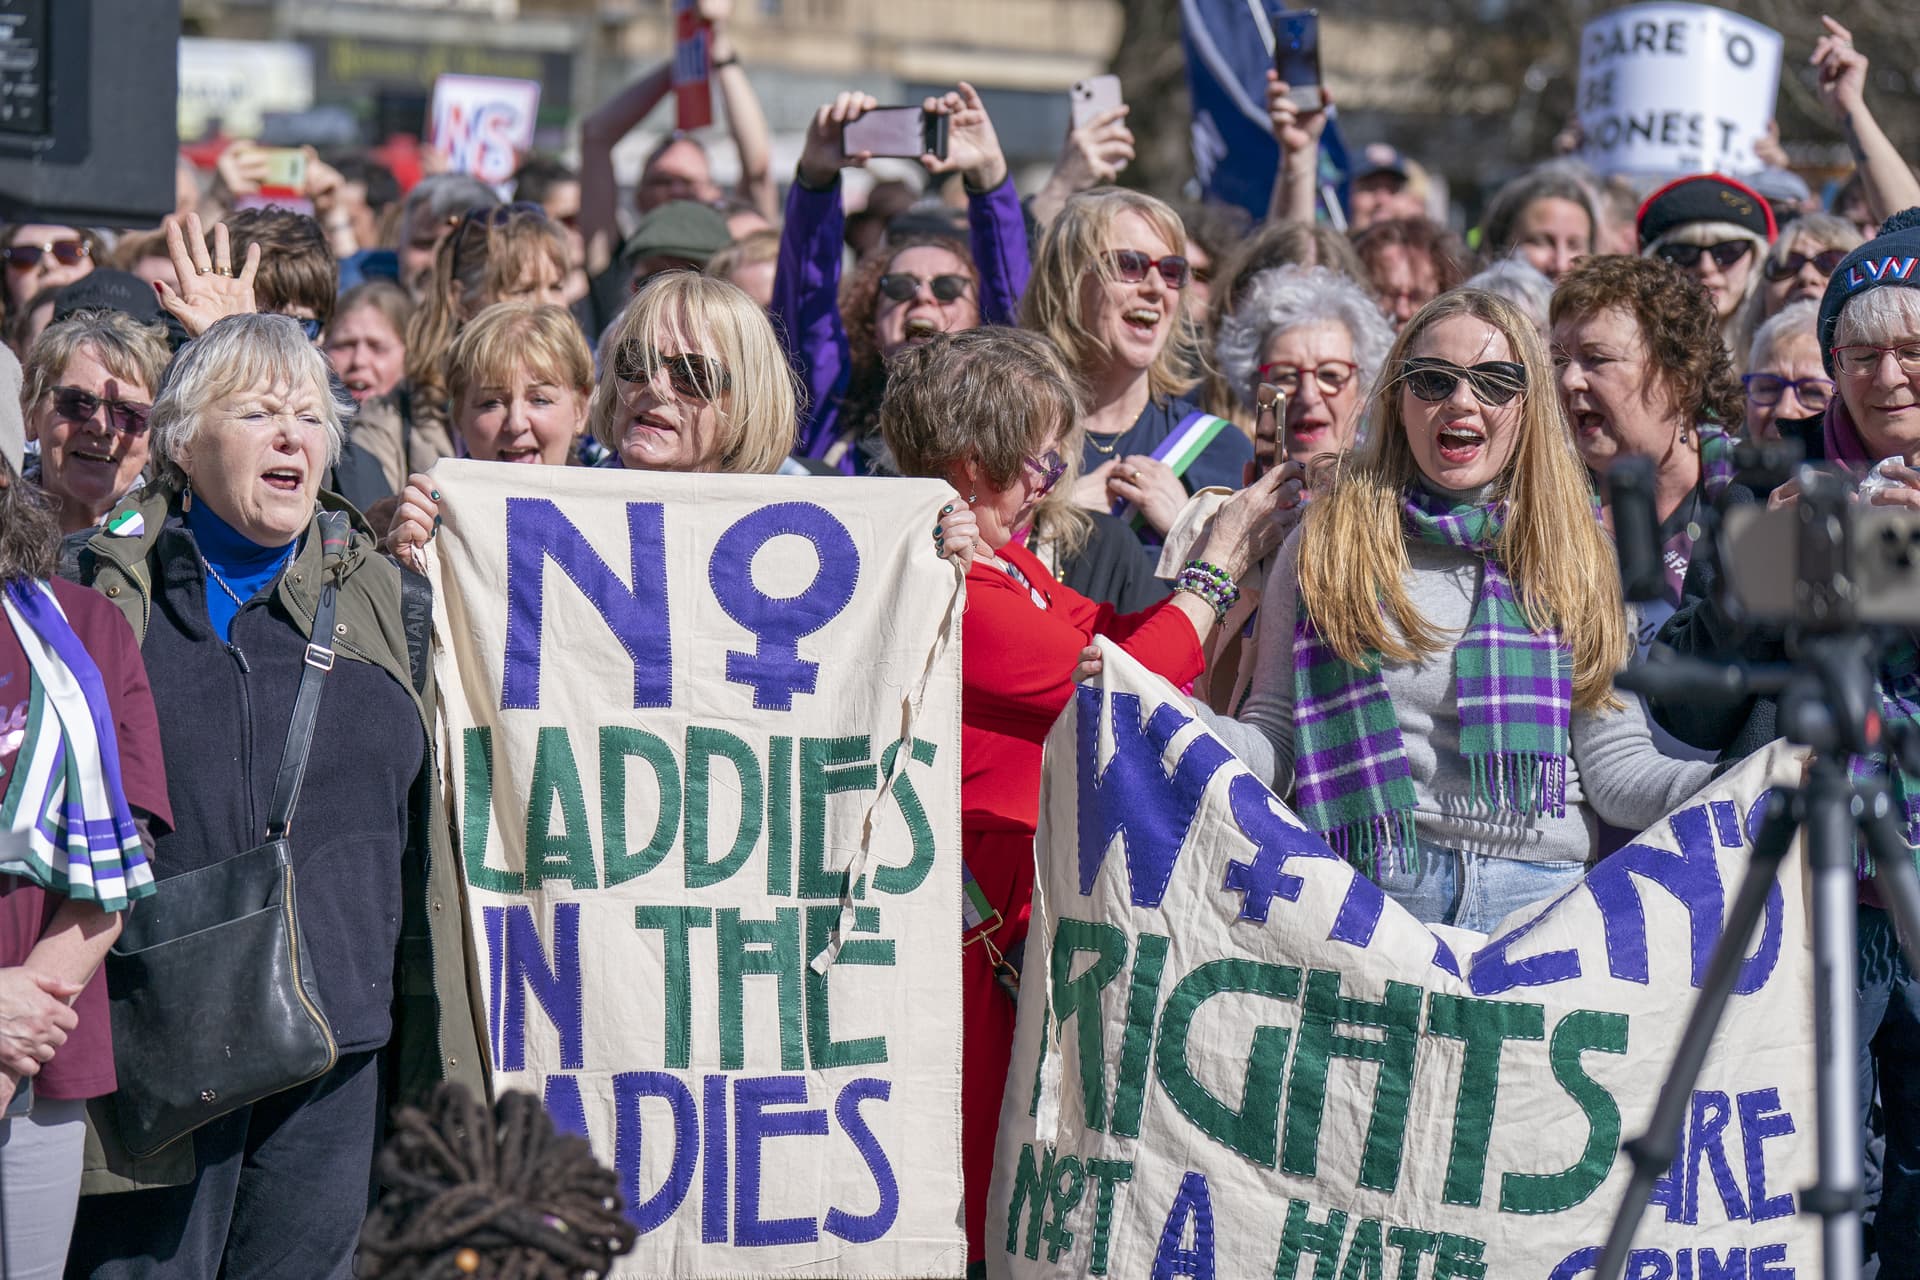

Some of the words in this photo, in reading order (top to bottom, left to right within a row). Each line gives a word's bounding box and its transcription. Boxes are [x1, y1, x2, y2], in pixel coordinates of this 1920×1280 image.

[1590, 112, 1744, 160] ONEST.
[500, 496, 861, 712] NO
[463, 725, 938, 900] LADDIES
[483, 903, 584, 1073] IN
[635, 904, 896, 1071] THE
[1028, 917, 1630, 1217] RIGHTS
[543, 1070, 900, 1248] DIES
[1006, 1143, 1133, 1275] NOT
[1151, 1171, 1217, 1280] A
